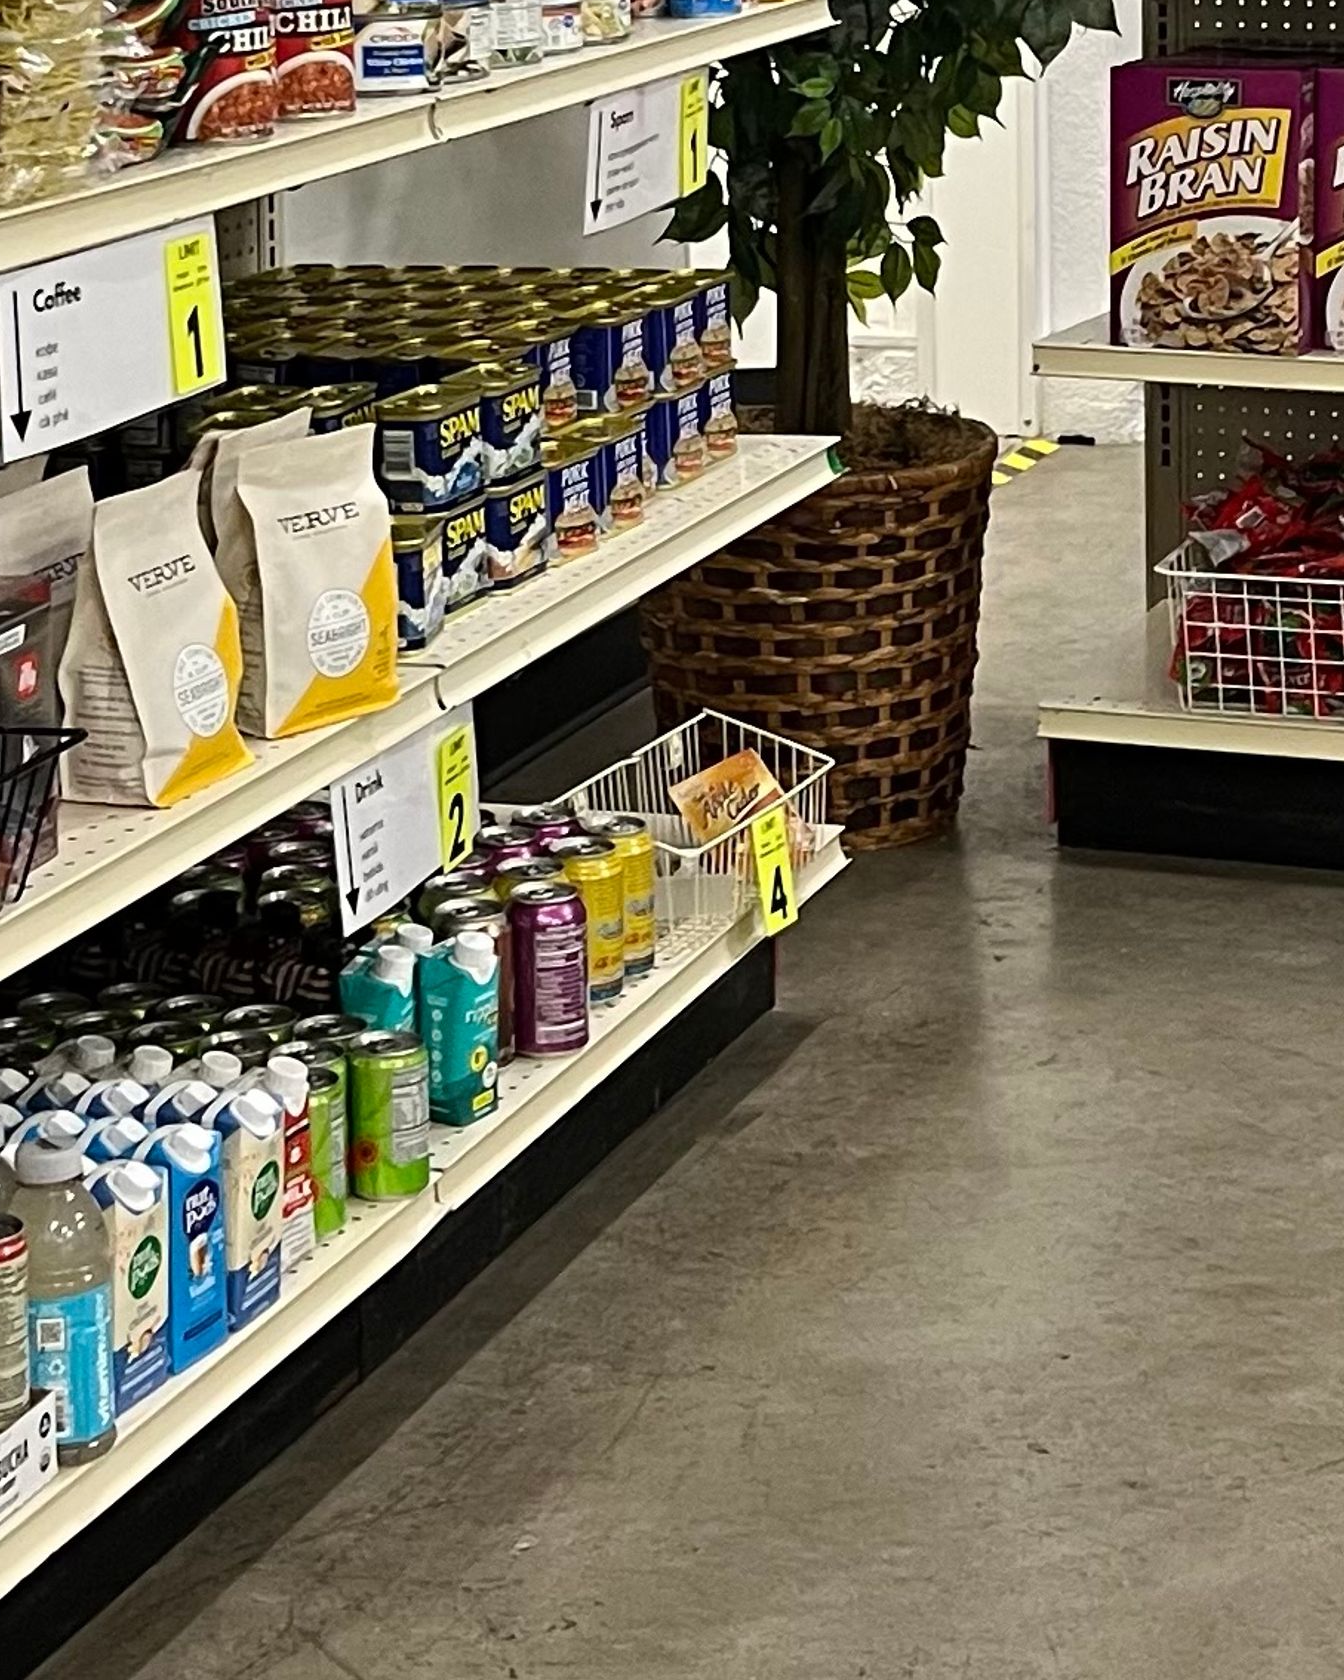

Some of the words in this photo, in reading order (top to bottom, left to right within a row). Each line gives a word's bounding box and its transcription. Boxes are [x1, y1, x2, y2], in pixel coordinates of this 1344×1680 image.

[690, 128, 698, 183] 1
[1126, 119, 1280, 187] RAISIN
[1137, 159, 1266, 219] BRAN
[33, 281, 81, 312] Coffee
[187, 305, 204, 378] 1
[502, 385, 539, 422] SPAM
[440, 407, 480, 448] SPAM
[277, 502, 360, 535] VERVE
[509, 483, 545, 524] SPAM
[446, 508, 486, 548] SPAM
[127, 554, 196, 593] VERVE
[355, 769, 384, 804] Drink
[449, 792, 465, 865] 2
[770, 865, 788, 919] 4
